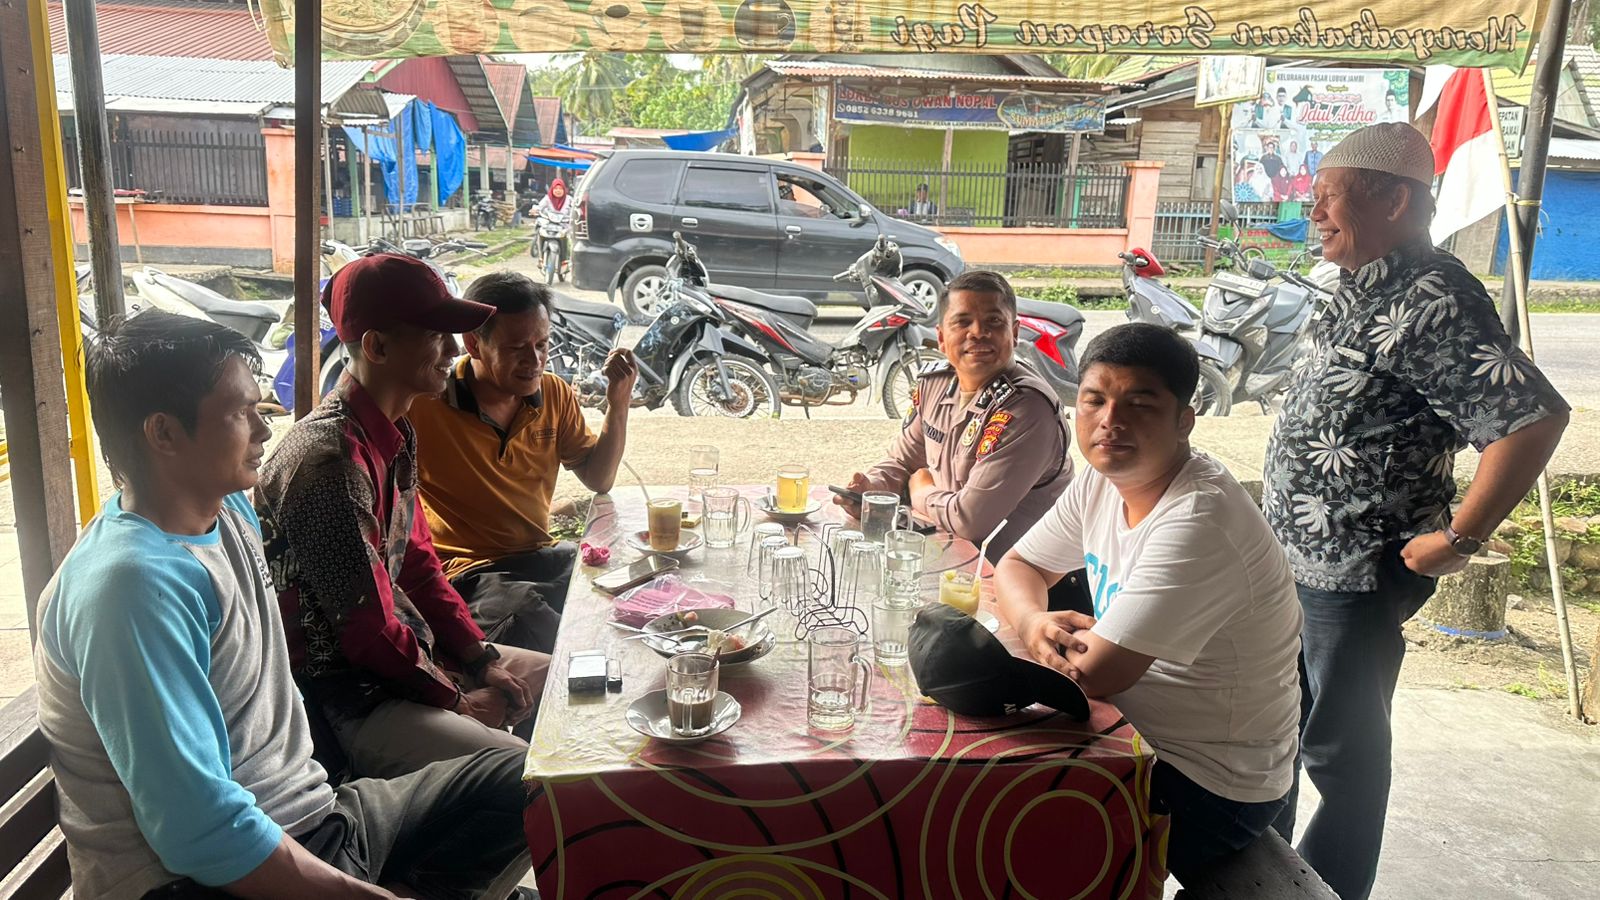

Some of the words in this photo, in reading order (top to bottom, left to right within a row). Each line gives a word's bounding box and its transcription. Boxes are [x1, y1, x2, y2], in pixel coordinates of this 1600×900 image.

[1310, 74, 1328, 82] PASAR
[1347, 75, 1364, 83] JAMBI
[955, 95, 998, 109] NOPAL
[845, 104, 869, 114] 0852
[1298, 103, 1332, 122] Idul
[1332, 103, 1375, 122] Adha
[1499, 111, 1518, 121] EPATAN
